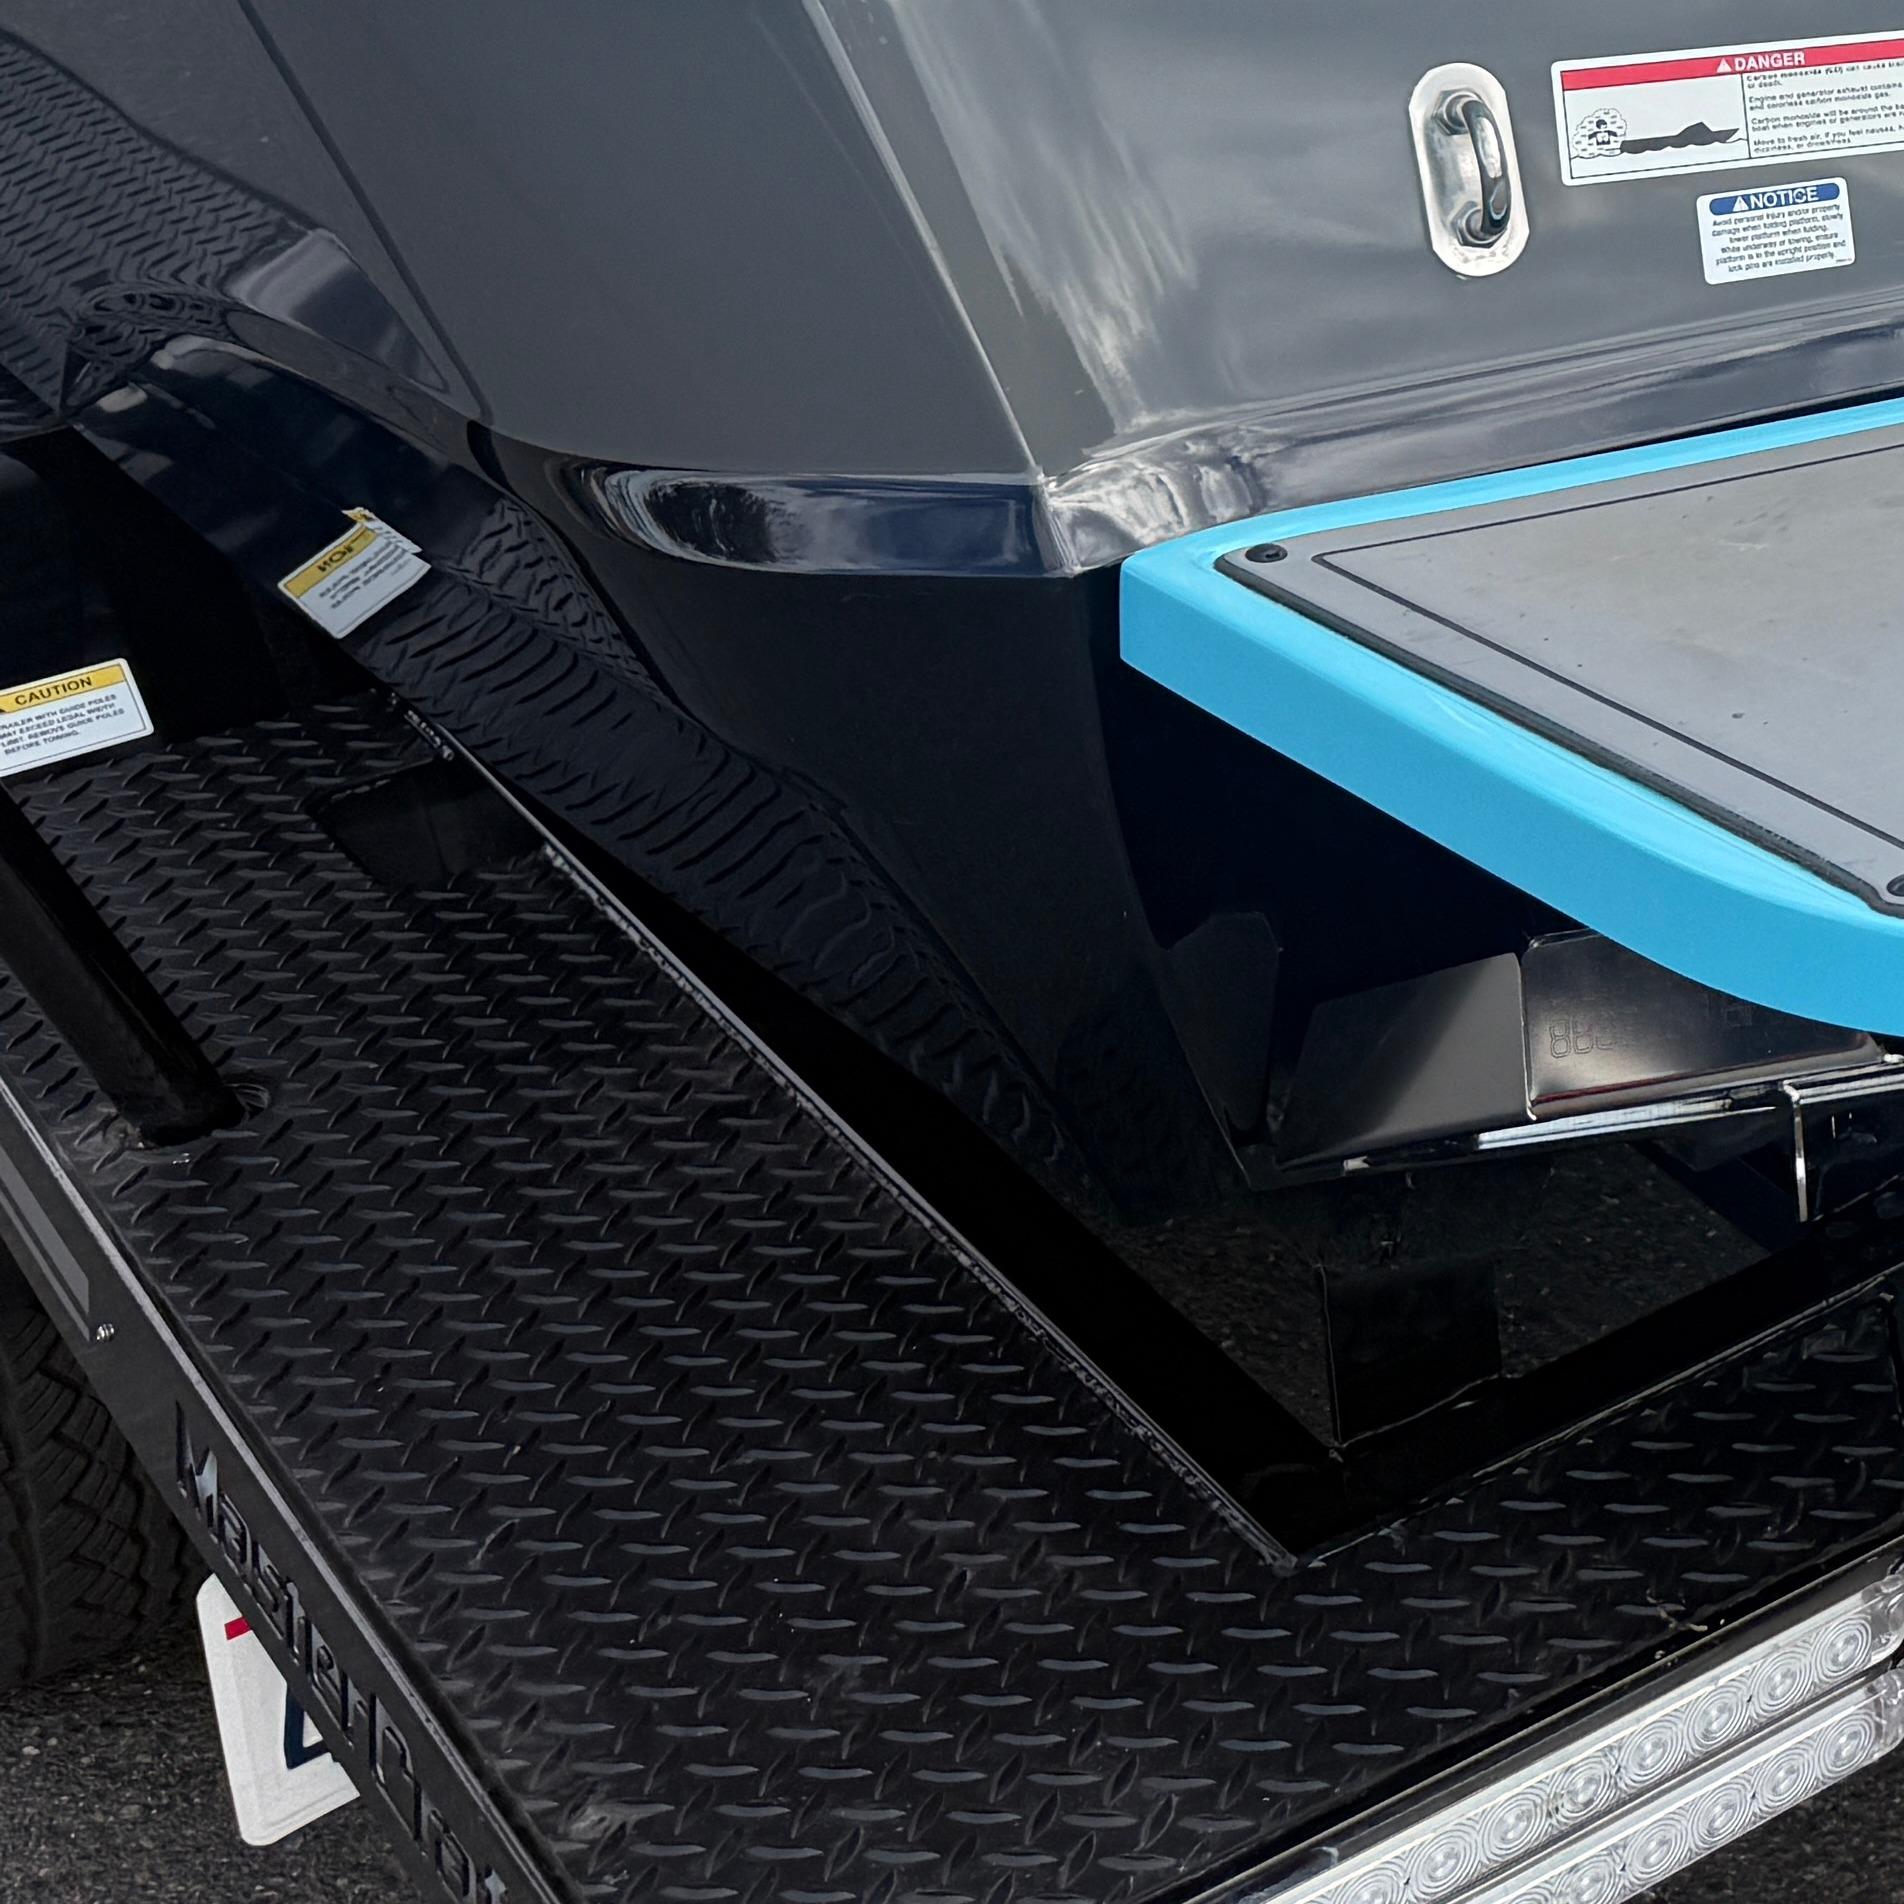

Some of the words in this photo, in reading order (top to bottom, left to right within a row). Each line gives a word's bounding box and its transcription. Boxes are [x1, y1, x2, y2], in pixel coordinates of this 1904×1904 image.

[1733, 50, 1806, 73] DANGER
[1749, 185, 1819, 209] NOTICE
[14, 675, 92, 706] CAUTION
[0, 716, 33, 732] RAILER
[34, 710, 57, 721] WITH
